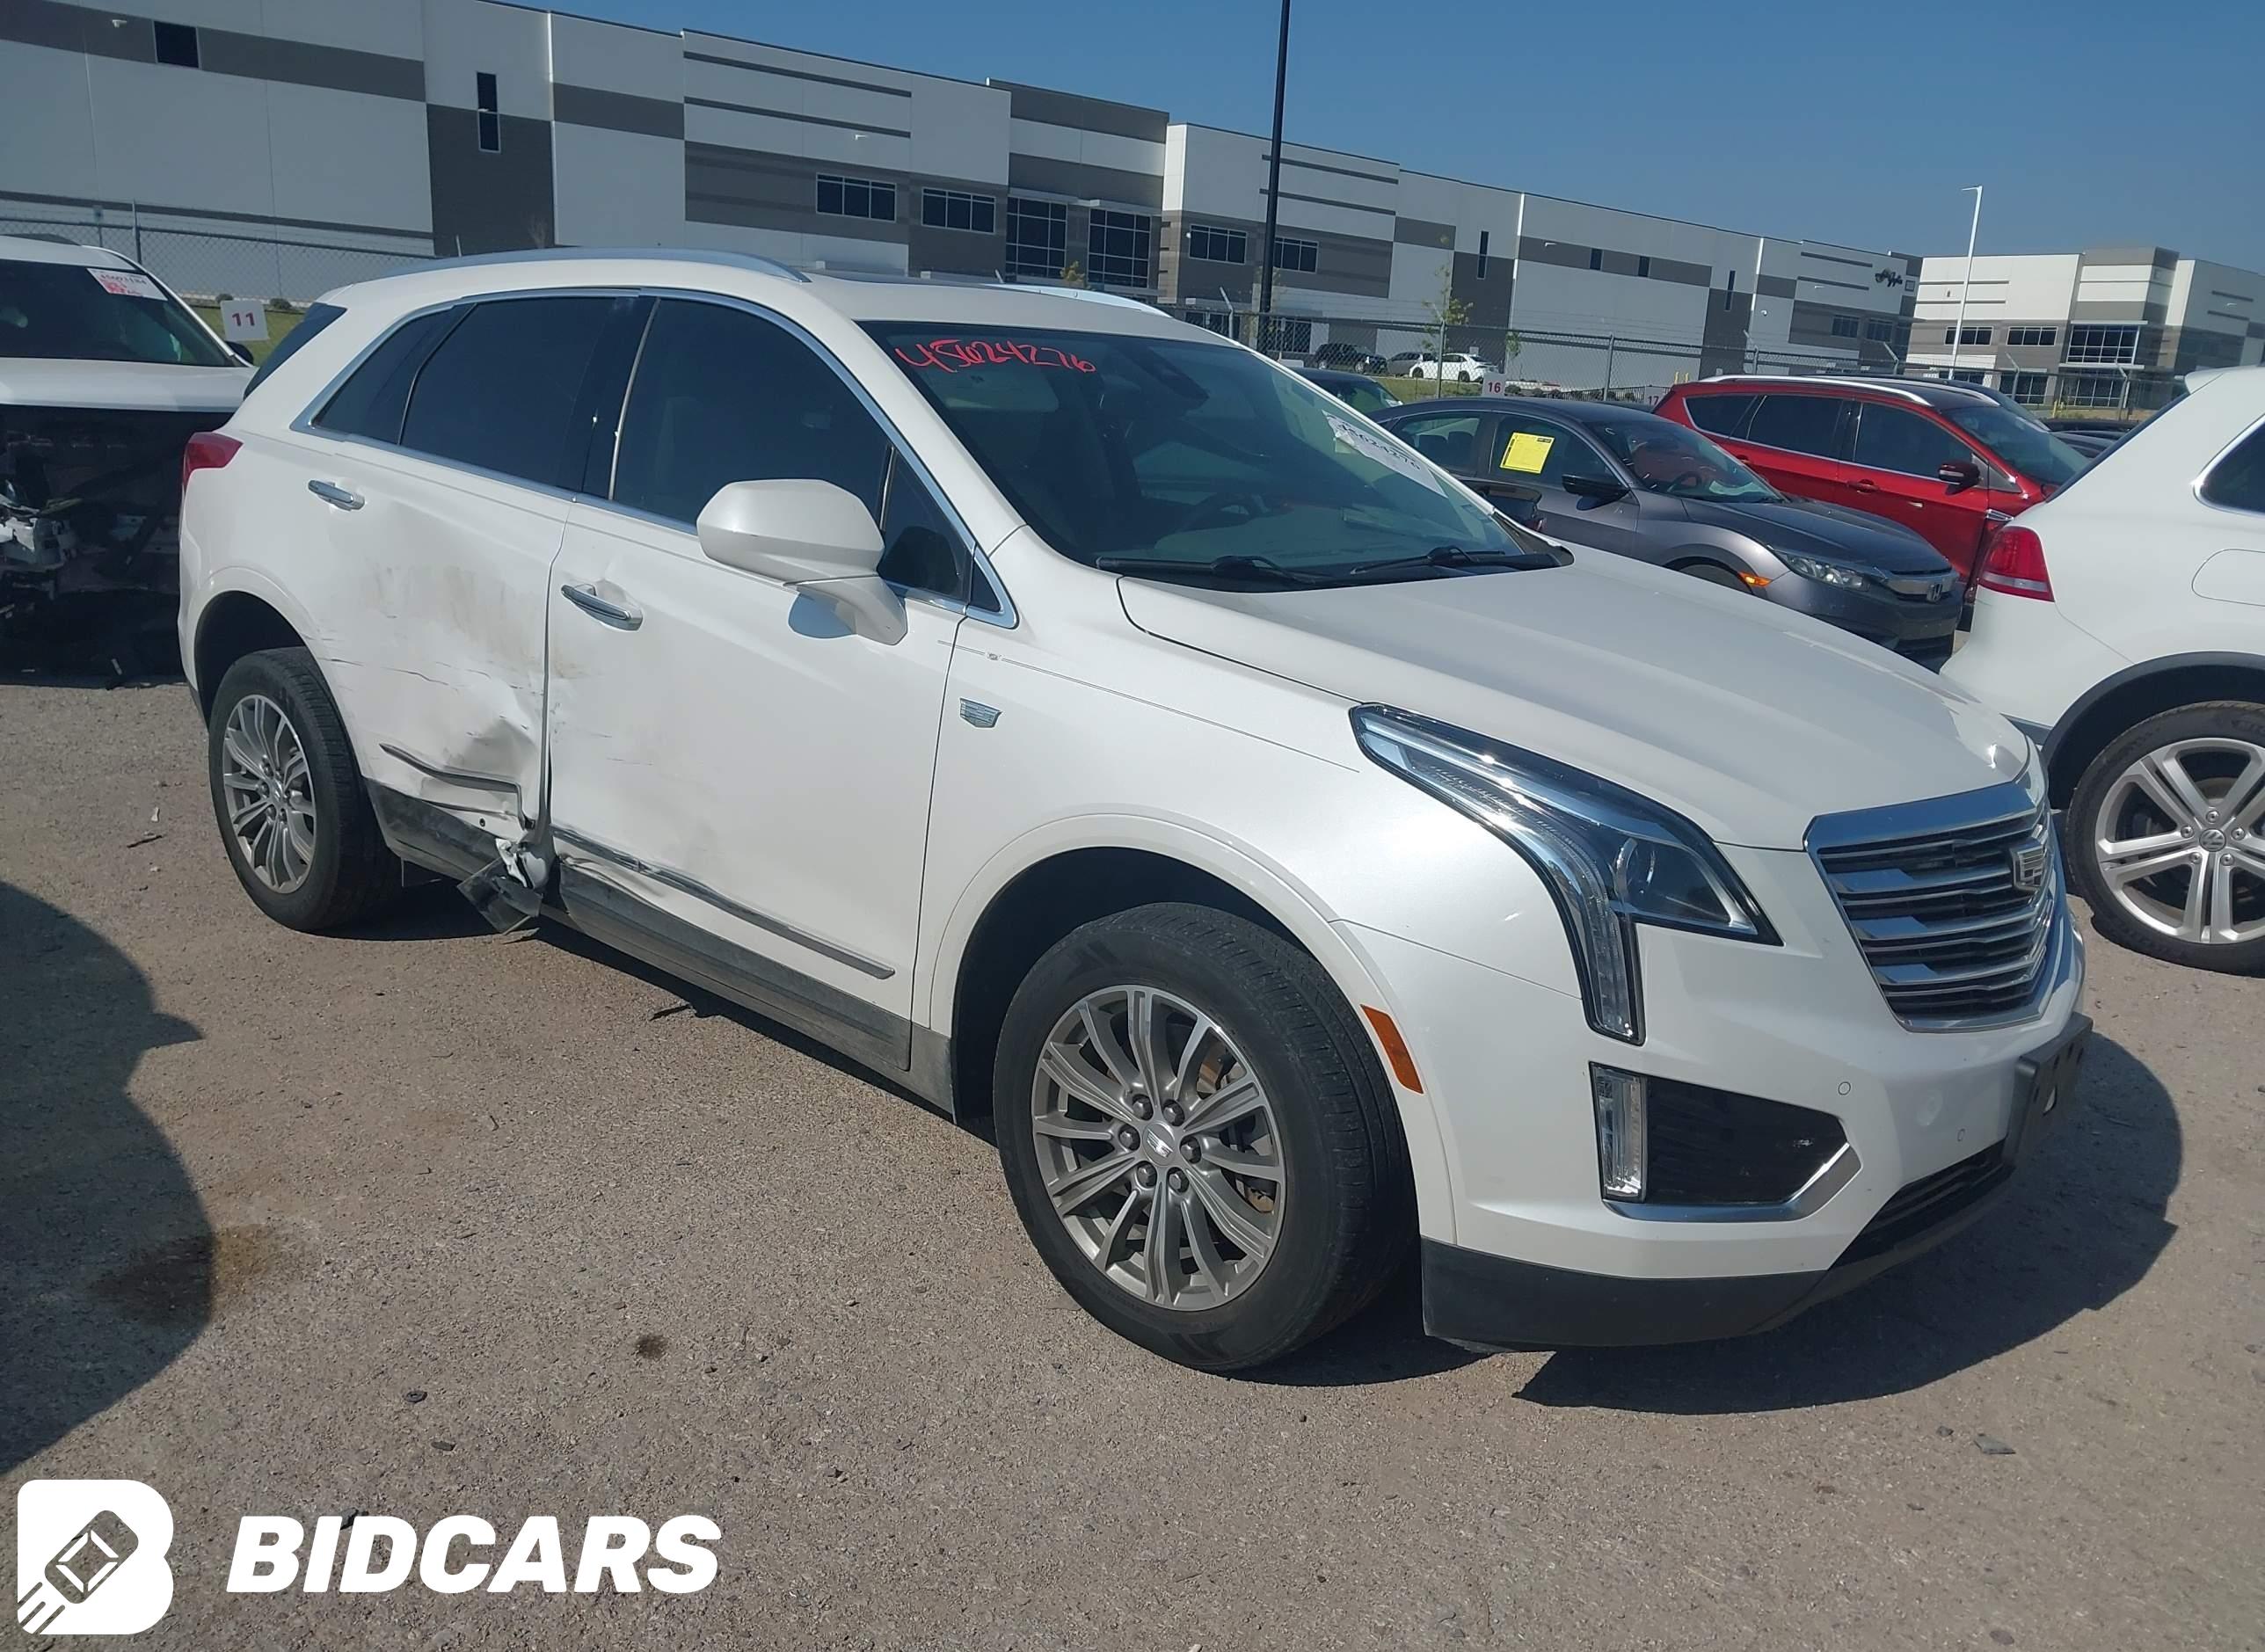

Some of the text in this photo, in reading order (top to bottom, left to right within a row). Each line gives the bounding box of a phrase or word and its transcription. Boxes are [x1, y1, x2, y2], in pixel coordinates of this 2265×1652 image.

[231, 312, 255, 326] 11
[1488, 382, 1501, 393] 16
[1648, 396, 1659, 405] 17
